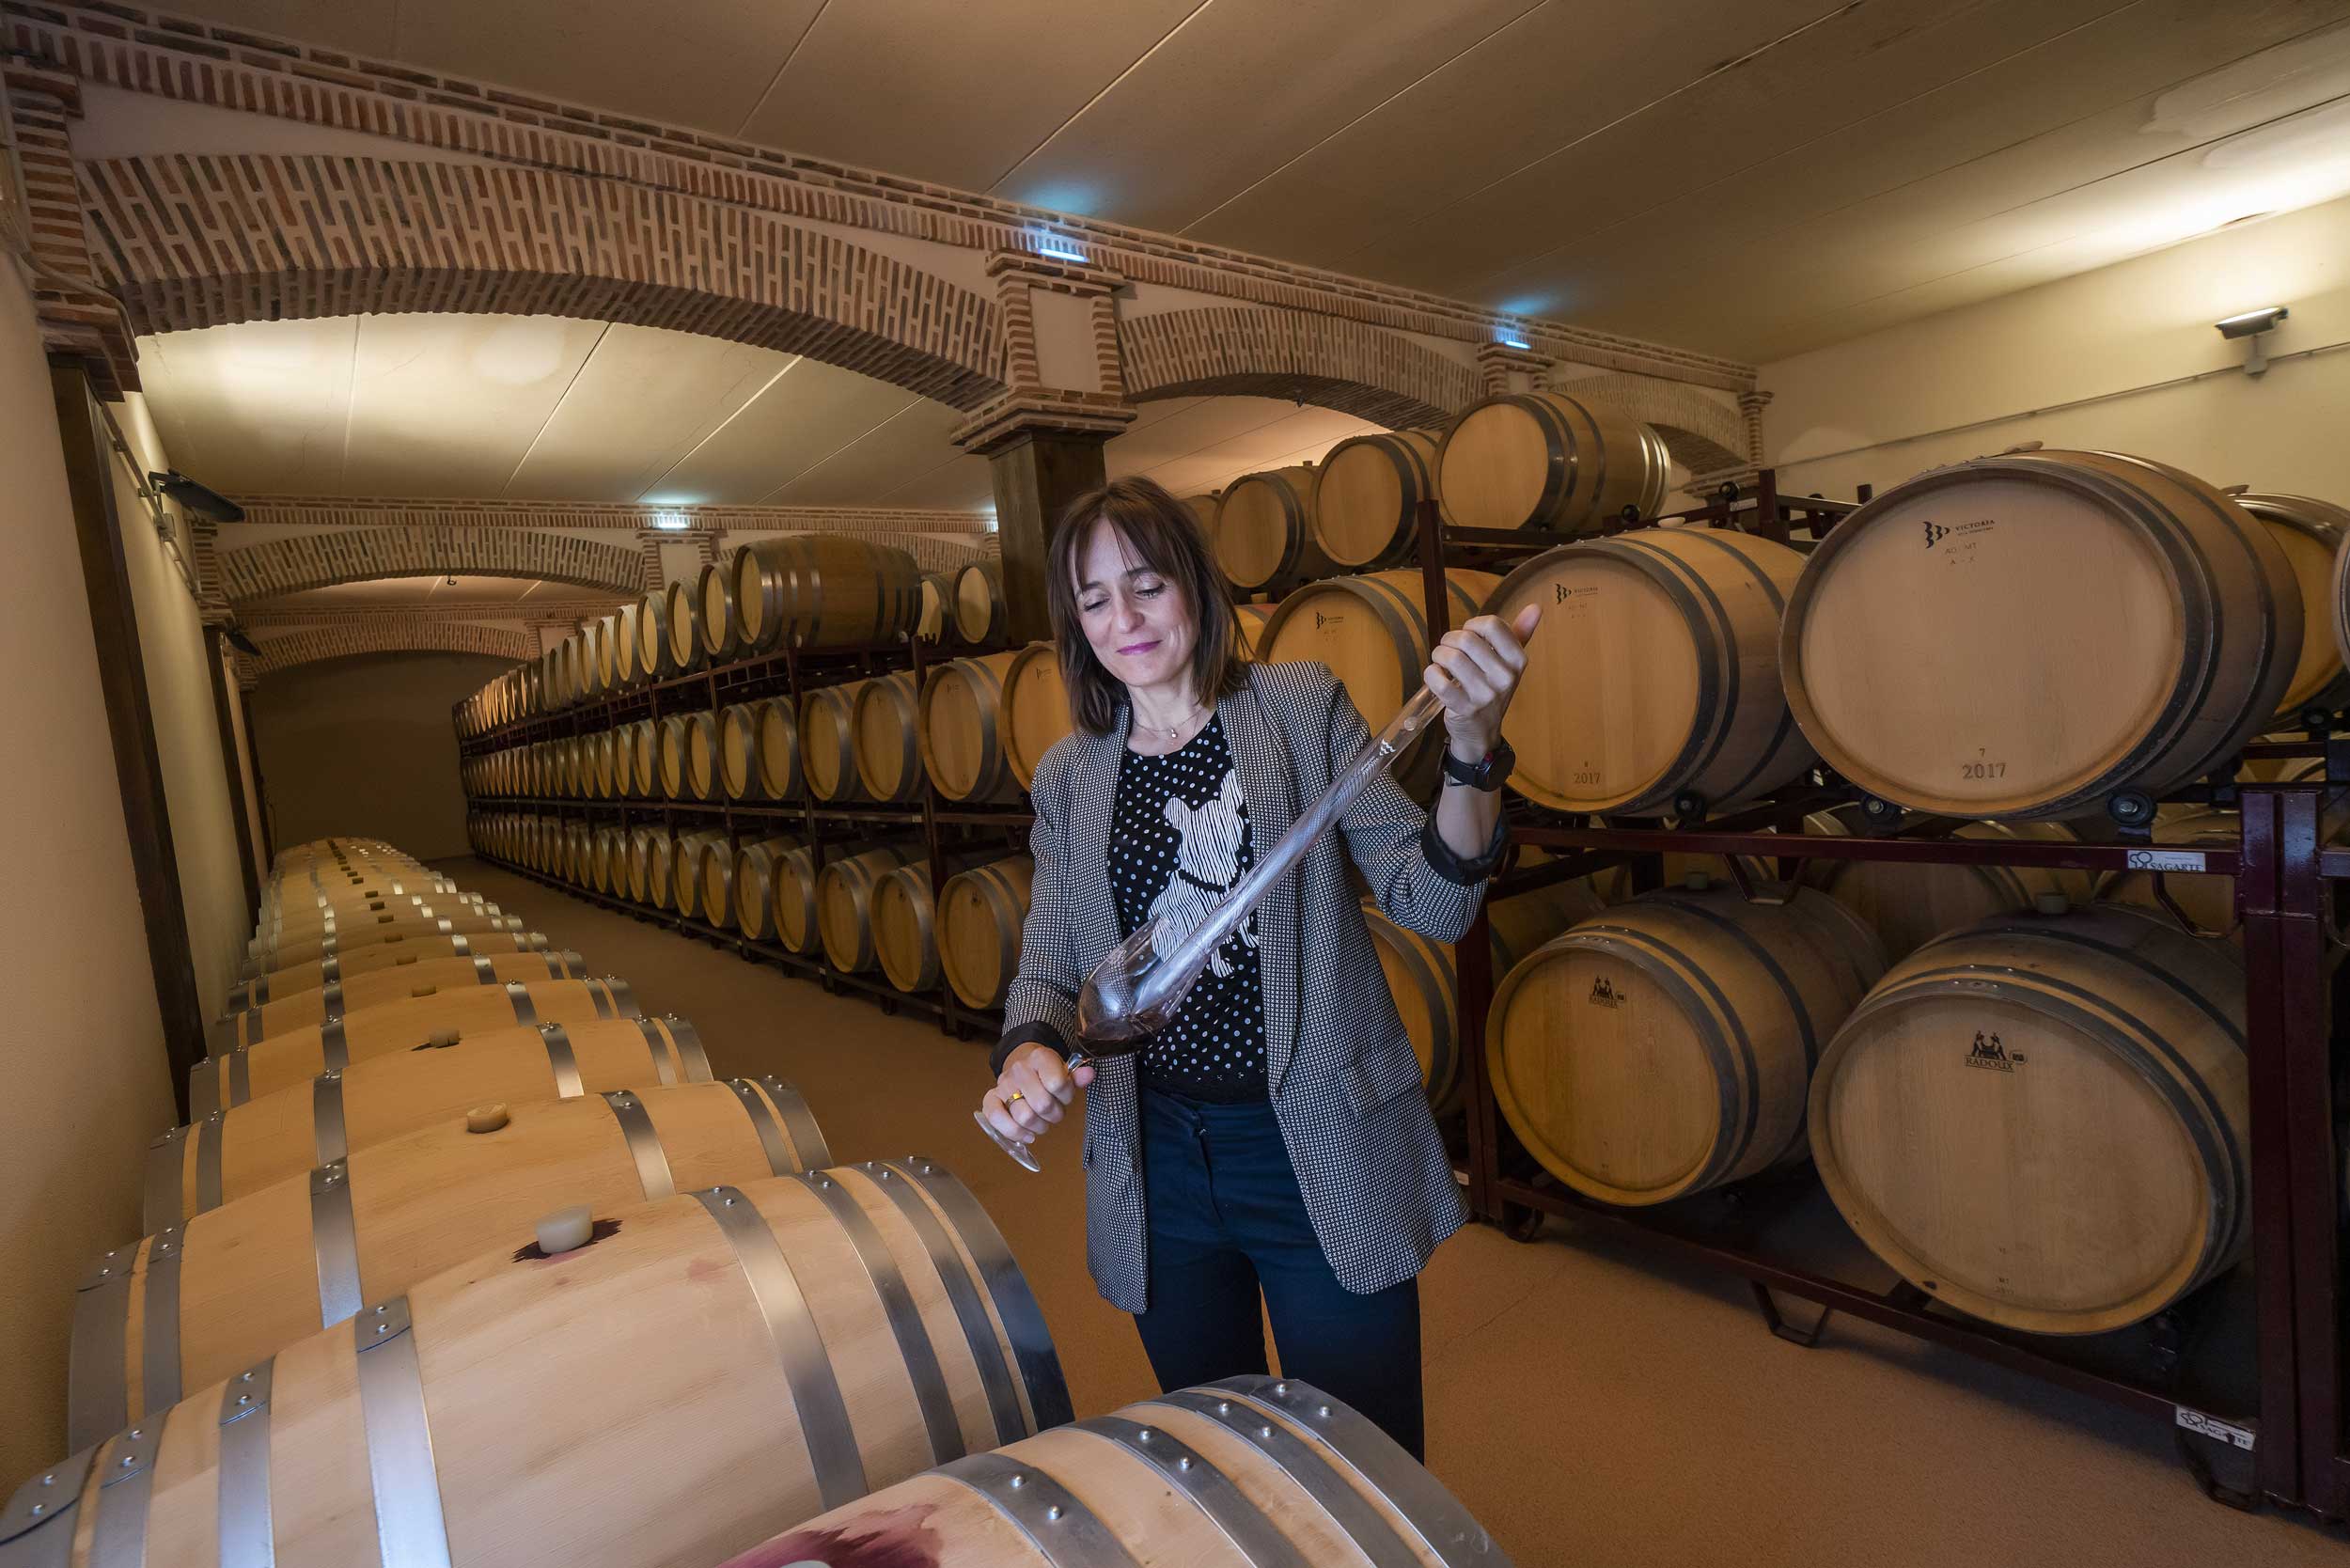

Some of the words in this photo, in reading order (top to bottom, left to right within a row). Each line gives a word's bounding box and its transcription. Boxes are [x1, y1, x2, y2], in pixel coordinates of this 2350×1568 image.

[1955, 520, 1996, 531] VICTORIA
[1962, 761, 2007, 779] 2017
[1573, 772, 1601, 784] 2017
[1965, 1057, 2014, 1071] RADOUX
